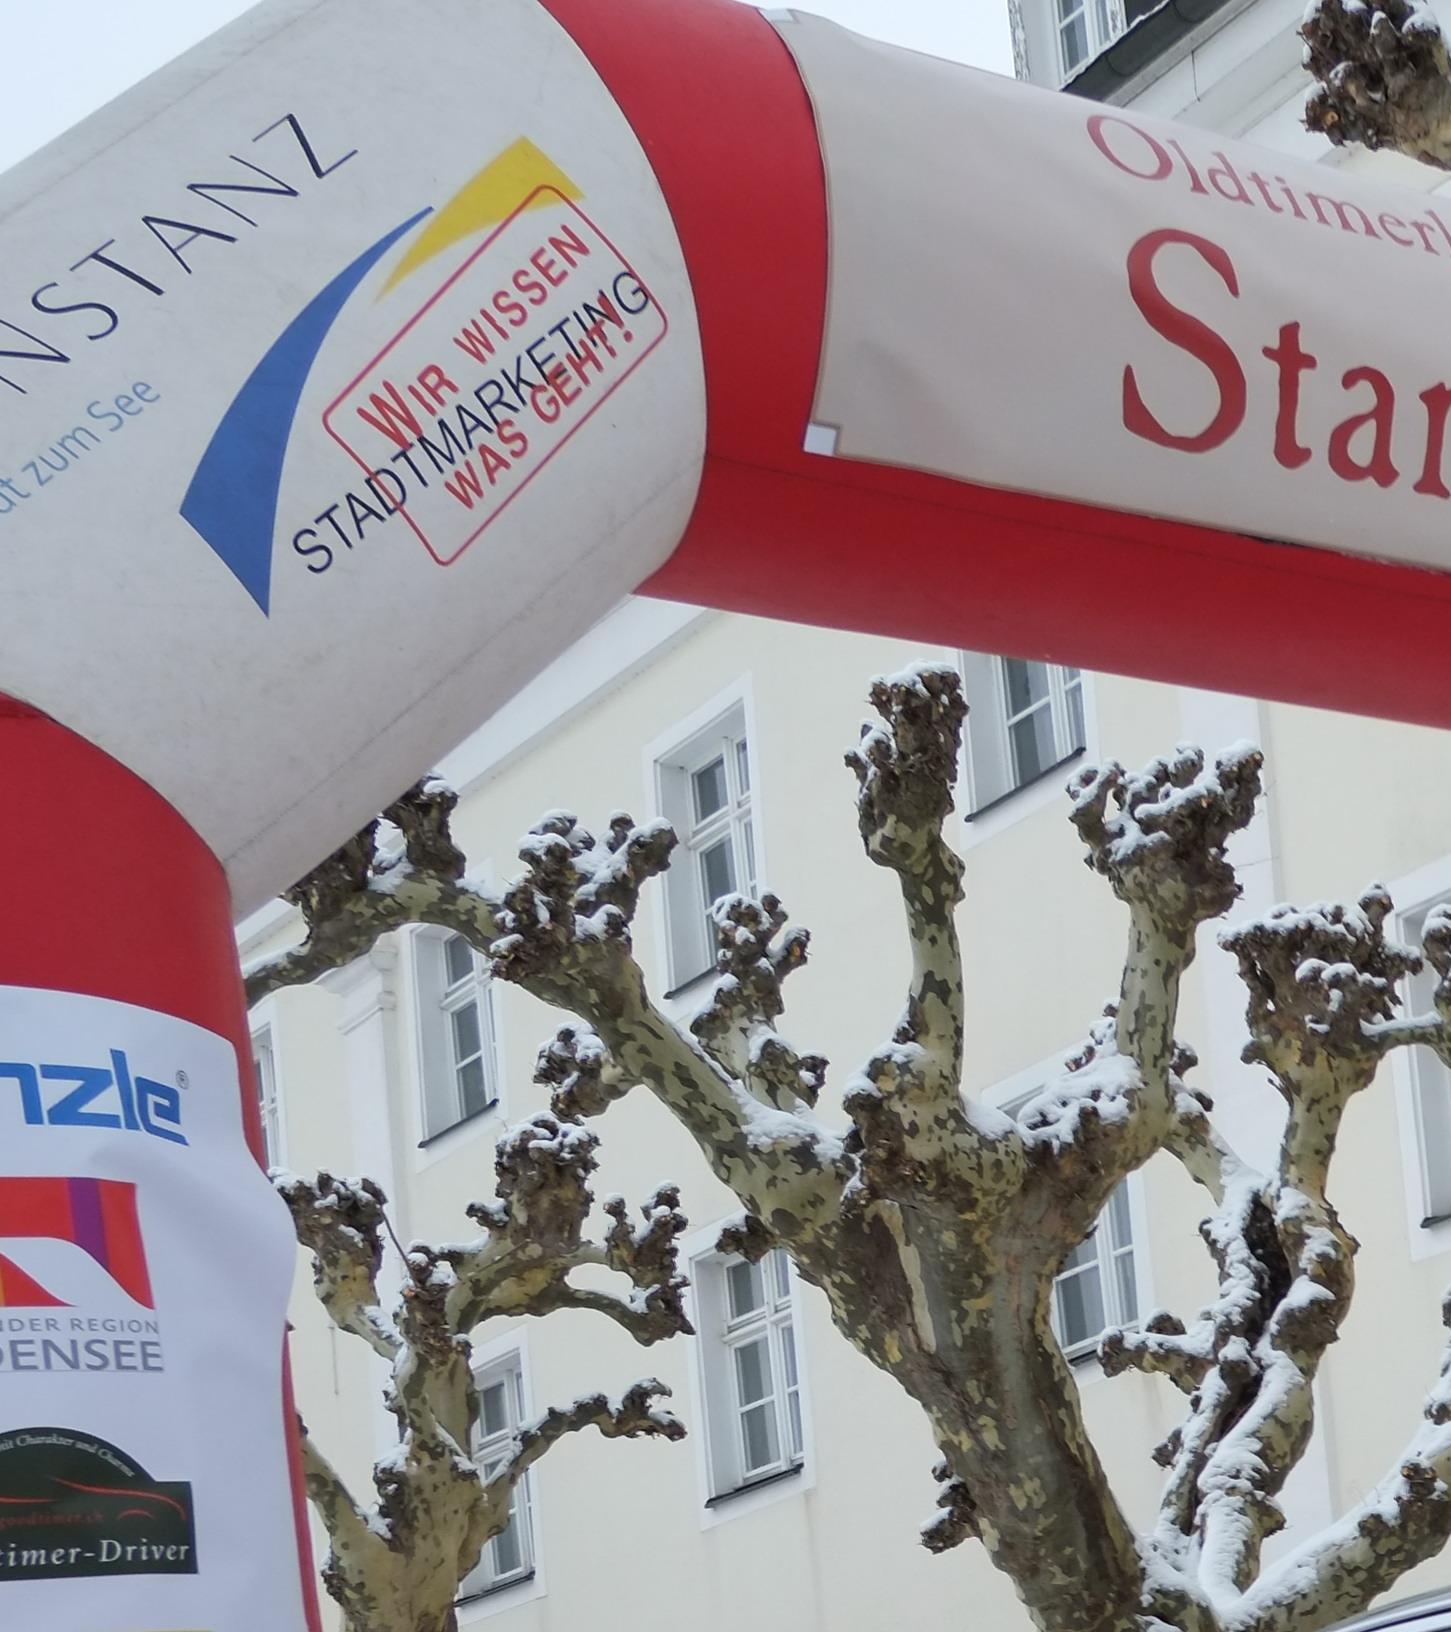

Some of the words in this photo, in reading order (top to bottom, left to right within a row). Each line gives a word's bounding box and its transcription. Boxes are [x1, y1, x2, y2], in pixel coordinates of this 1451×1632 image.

[356, 363, 460, 451] WIR
[453, 224, 590, 364] WISSEN
[21, 427, 101, 487] zum
[87, 381, 161, 432] See
[292, 271, 651, 574] STADTMARKETING
[444, 418, 529, 510] WAS
[0, 1339, 164, 1371] ENSEE
[70, 1318, 159, 1334] REGION
